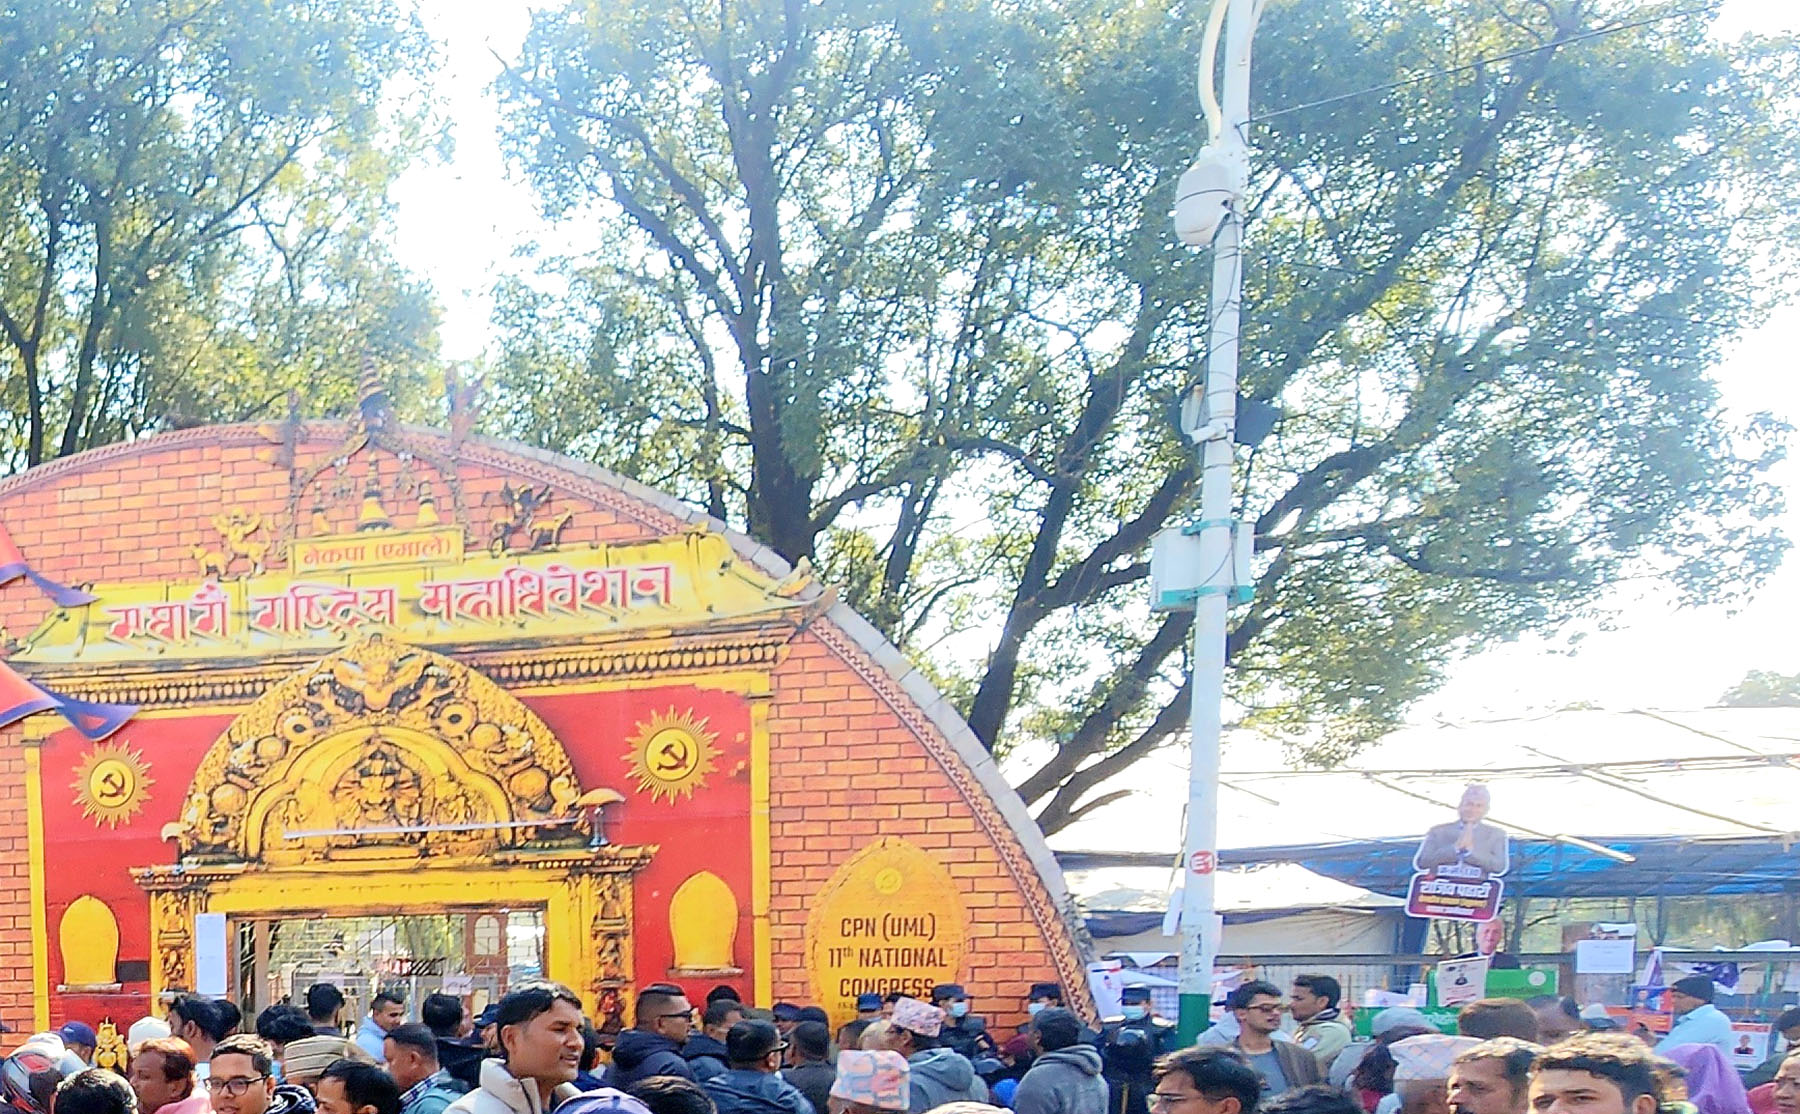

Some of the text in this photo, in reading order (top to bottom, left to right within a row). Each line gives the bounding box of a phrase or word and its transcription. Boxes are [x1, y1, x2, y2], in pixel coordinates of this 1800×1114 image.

[303, 532, 450, 565] नेकपा (एमाले)
[420, 564, 672, 618] महाधिवेशन
[841, 912, 936, 942] CPN (UML)
[828, 946, 948, 968] 11th NATIONAL
[839, 978, 934, 998] CONGRESS
